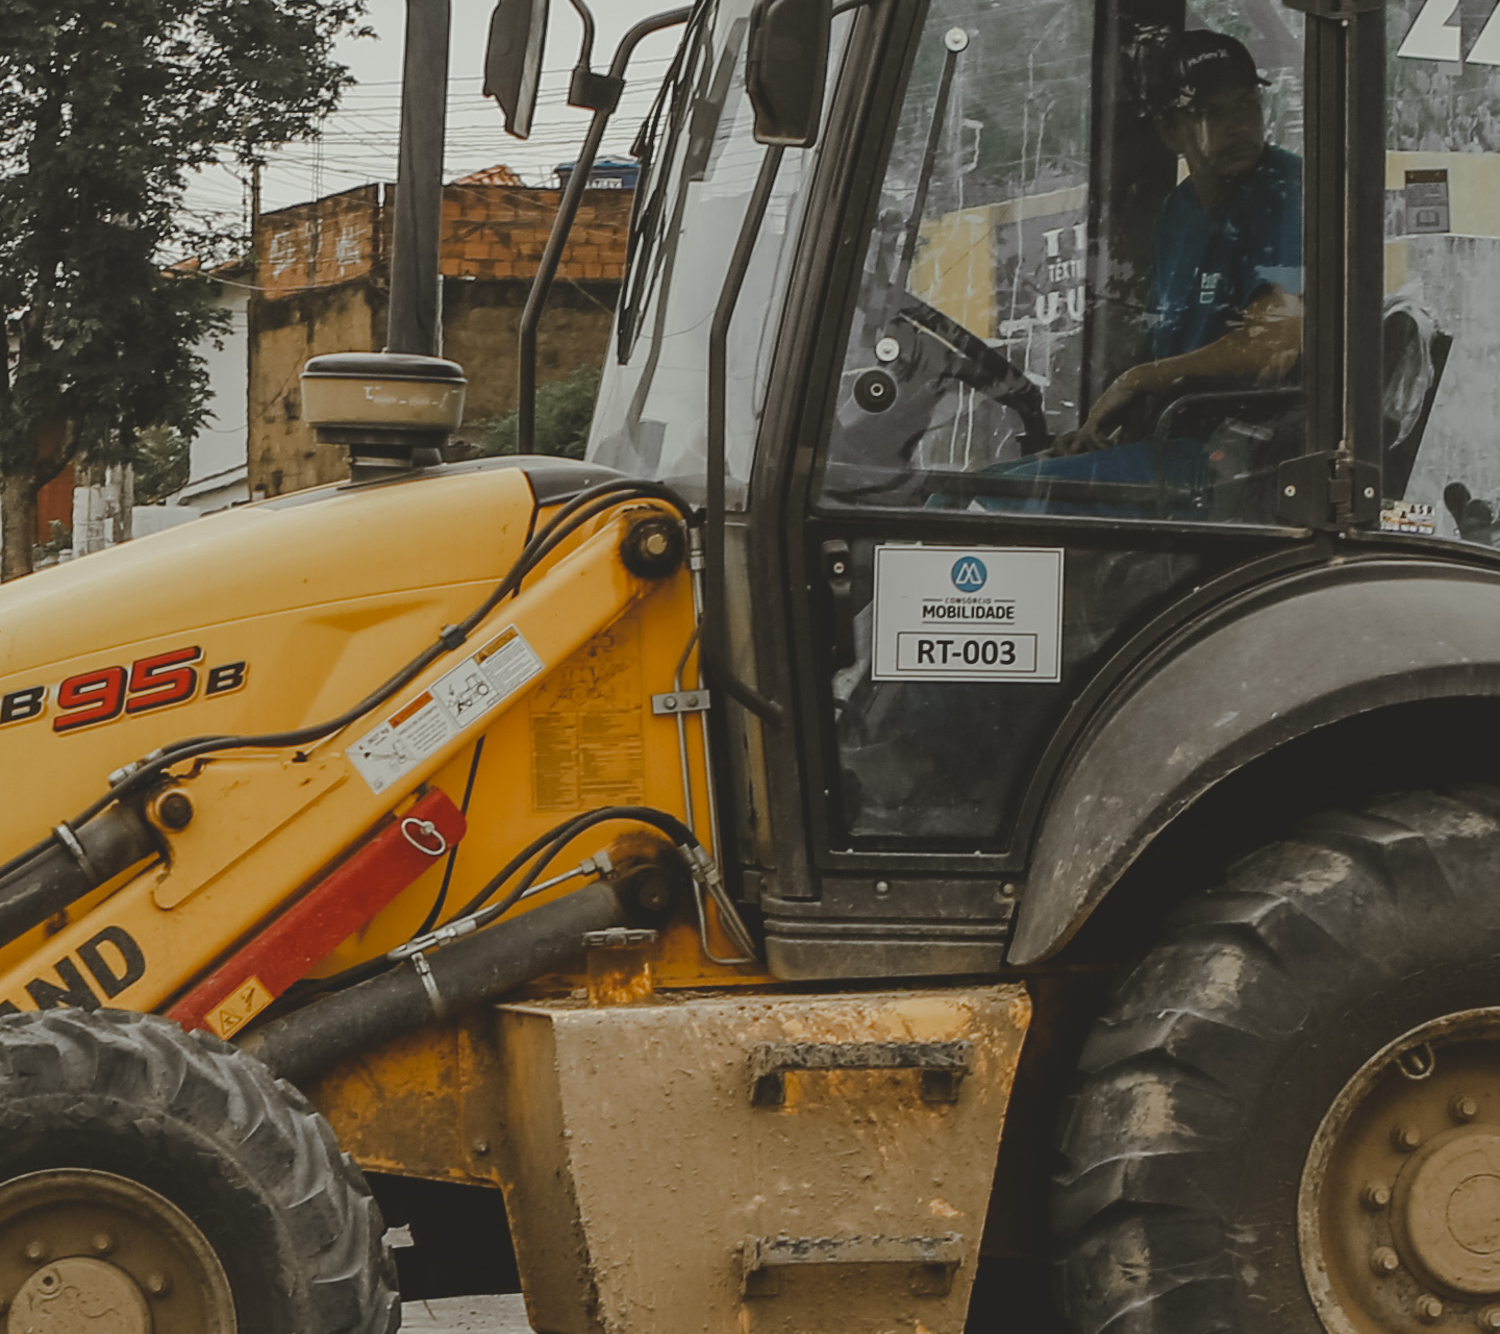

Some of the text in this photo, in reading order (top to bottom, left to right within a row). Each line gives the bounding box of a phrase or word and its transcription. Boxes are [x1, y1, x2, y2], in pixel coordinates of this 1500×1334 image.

[922, 605, 1015, 620] MOBILIDADE
[917, 639, 1016, 665] RT-003
[53, 645, 202, 733] 95
[205, 661, 246, 696] B
